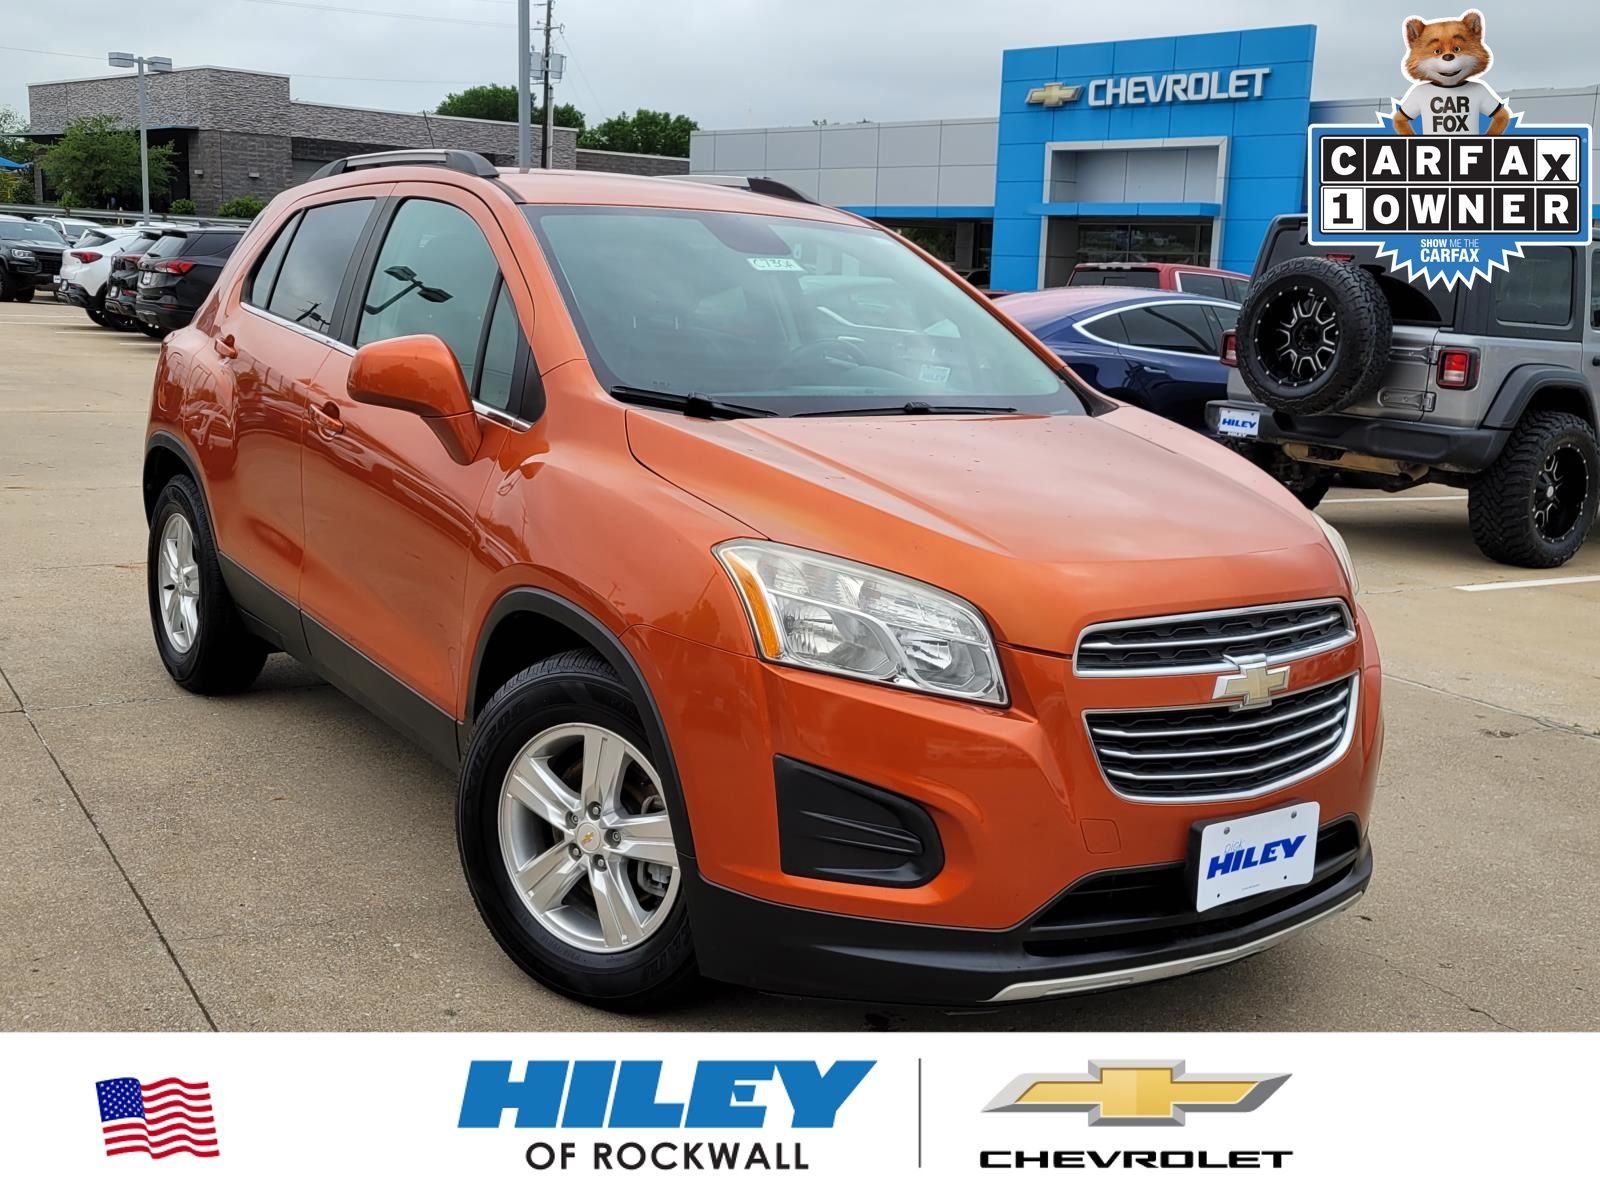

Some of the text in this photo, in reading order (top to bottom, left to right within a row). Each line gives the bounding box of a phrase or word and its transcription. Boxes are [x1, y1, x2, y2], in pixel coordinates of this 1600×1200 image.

[1088, 67, 1272, 107] CHEVROLET
[1222, 418, 1257, 429] HILEY
[1206, 834, 1307, 880] HILEY
